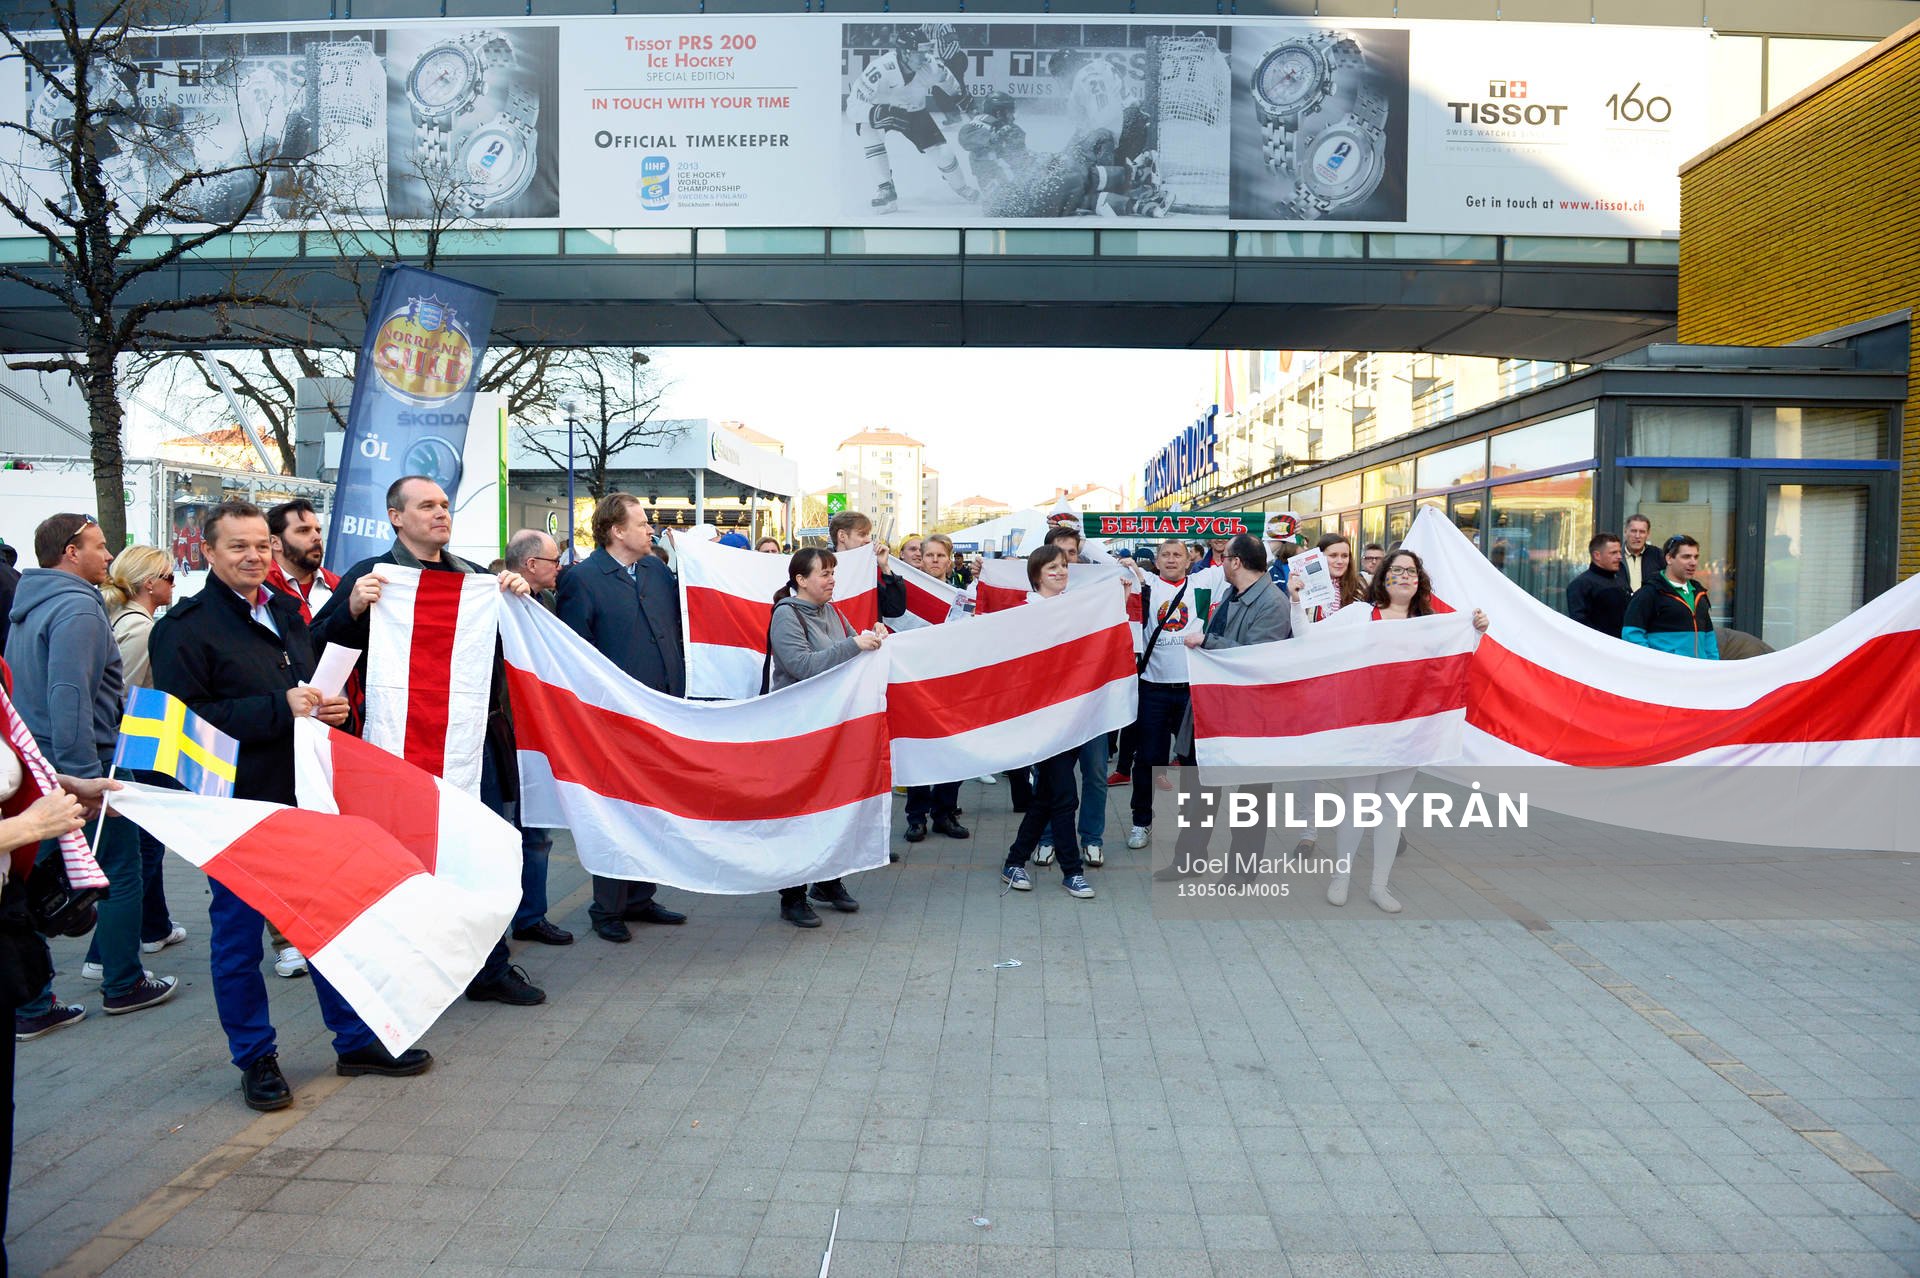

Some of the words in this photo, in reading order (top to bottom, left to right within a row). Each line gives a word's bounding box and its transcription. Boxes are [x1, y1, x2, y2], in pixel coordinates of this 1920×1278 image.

[678, 35, 713, 51] PRS
[720, 34, 757, 50] 200
[646, 72, 688, 82] SPECIAL
[691, 71, 736, 81] EDITION
[592, 98, 608, 110] IN
[613, 98, 663, 110] TOUCH
[667, 97, 705, 109] WITH
[710, 97, 752, 108] YOUR
[757, 96, 790, 108] TIME
[1605, 82, 1672, 123] 160
[1447, 102, 1568, 126] TISSOT
[686, 134, 790, 148] TIMEKEEPER
[1446, 129, 1474, 137] SWISS
[645, 162, 667, 171] IIHF
[677, 162, 699, 171] 2013
[1466, 195, 1486, 209] Get
[1491, 196, 1502, 208] in
[1507, 196, 1538, 209] touch
[1542, 198, 1554, 210] at
[1559, 199, 1645, 212] www.tissot.ch
[379, 341, 467, 385] GULD
[360, 433, 391, 462] ÖL
[342, 515, 391, 541] BIER
[1099, 515, 1248, 536] БЕЛАРУСЬ
